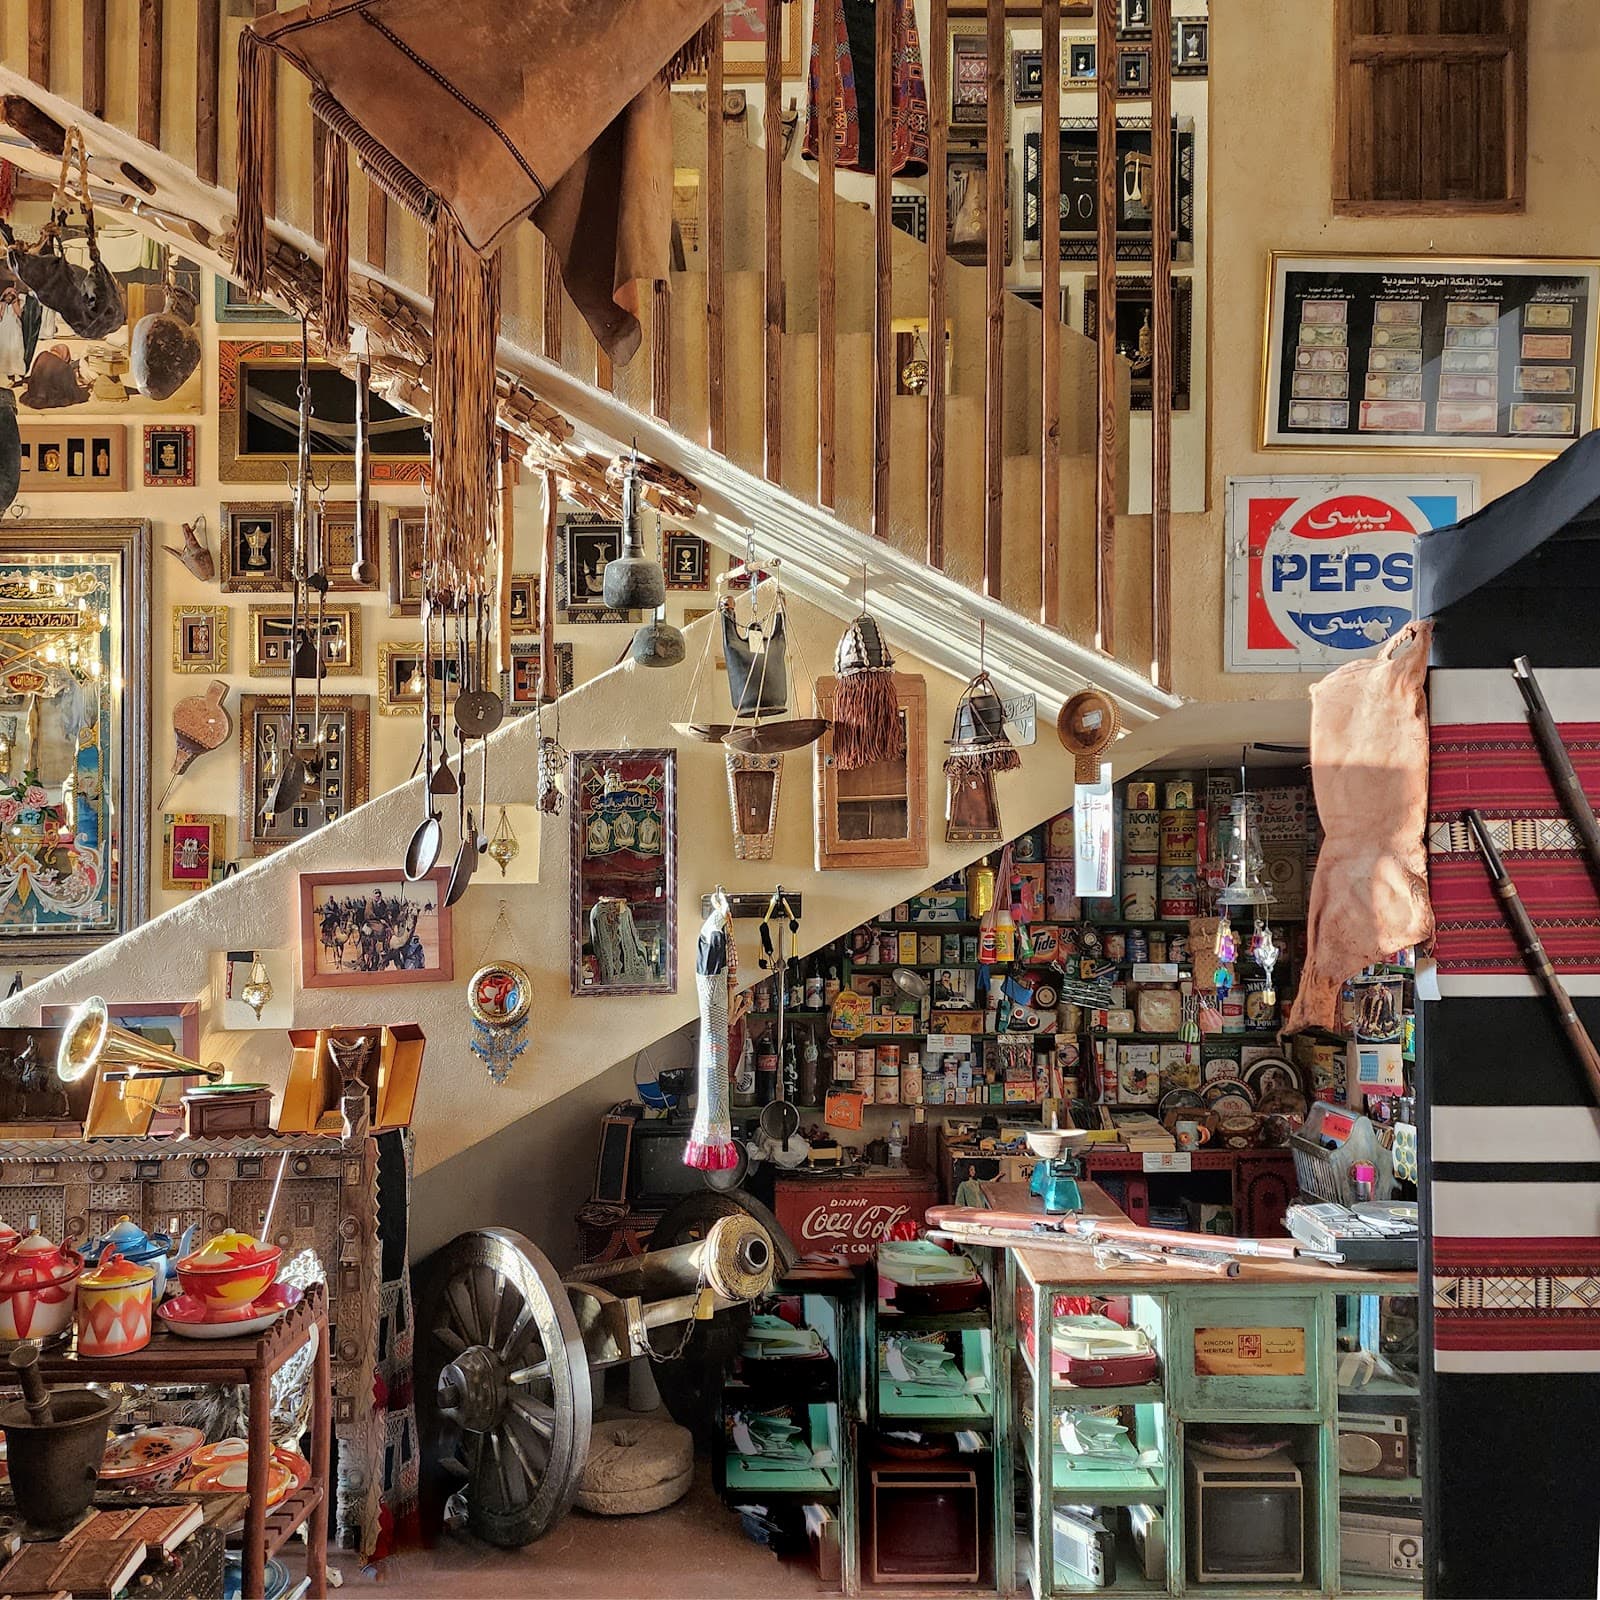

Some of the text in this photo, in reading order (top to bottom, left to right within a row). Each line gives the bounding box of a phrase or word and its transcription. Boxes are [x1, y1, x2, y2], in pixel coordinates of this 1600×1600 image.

[1382, 275, 1419, 286] السعودية
[1421, 276, 1450, 287] العربية
[1450, 277, 1477, 287] المملكة
[1272, 552, 1413, 592] PEPS
[1272, 792, 1288, 800] TEA
[1264, 815, 1295, 824] RABEA
[1032, 931, 1057, 955] Tide
[830, 1198, 869, 1207] DRINK
[802, 1204, 911, 1240] Coca Col
